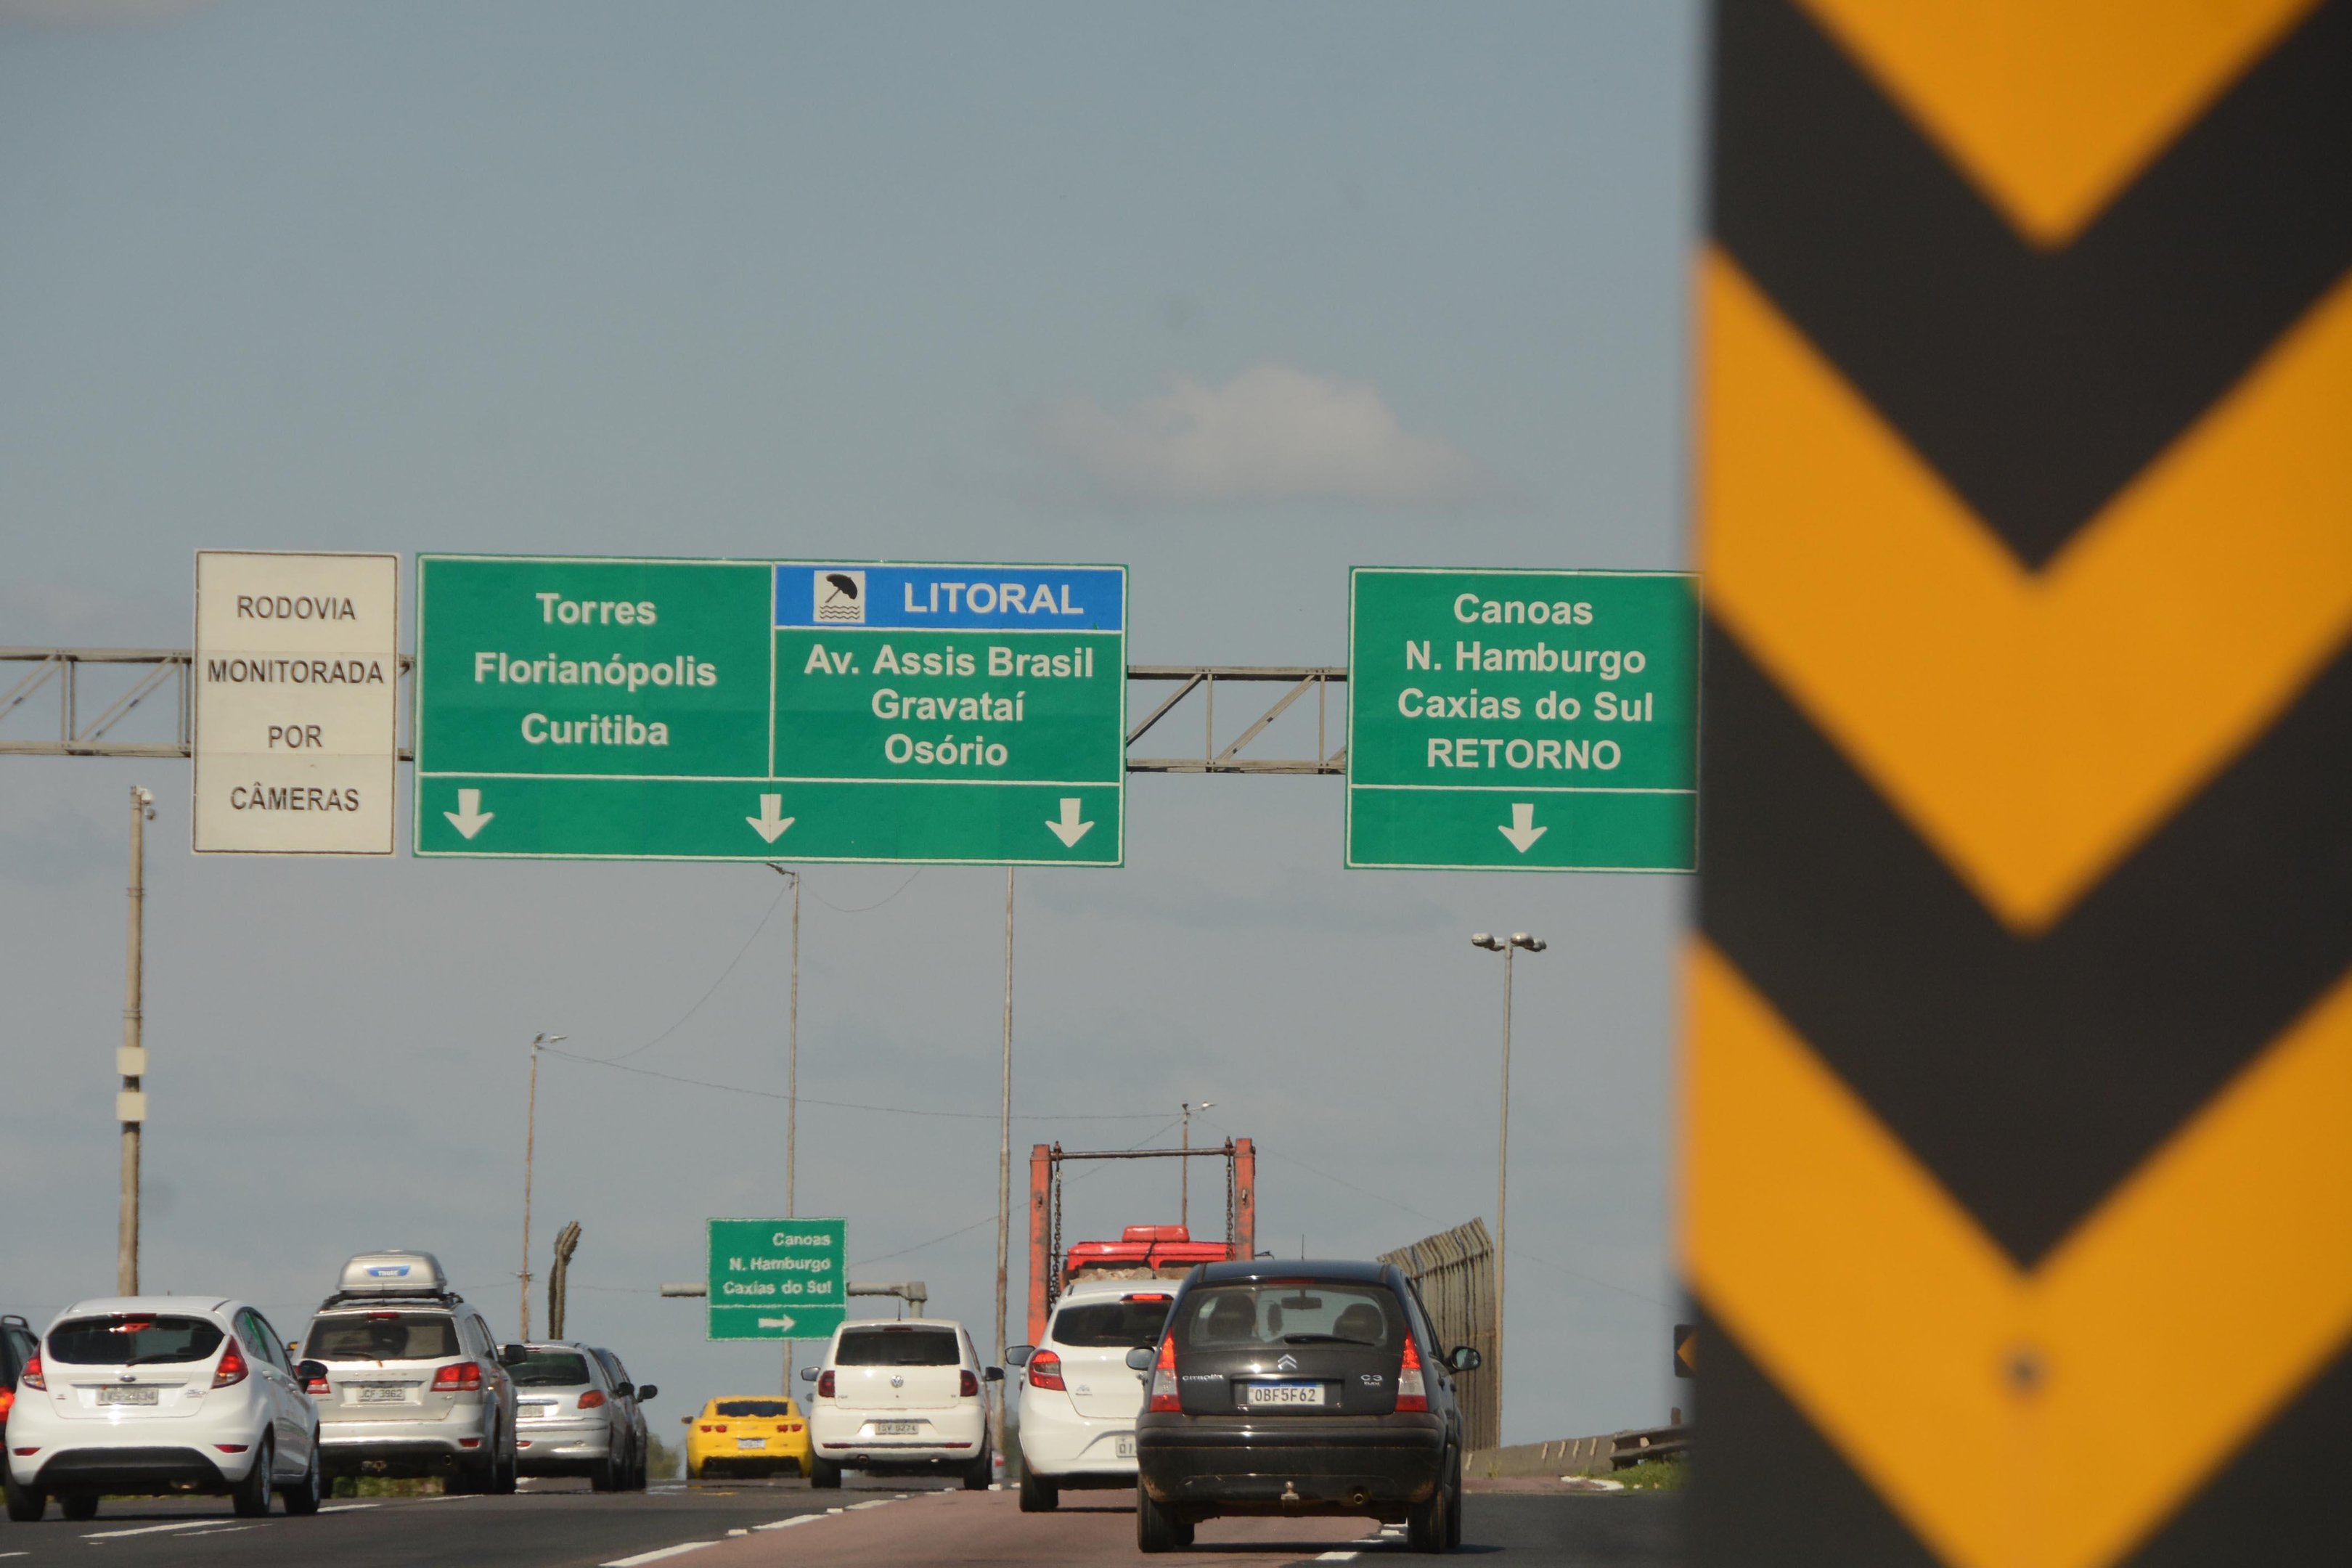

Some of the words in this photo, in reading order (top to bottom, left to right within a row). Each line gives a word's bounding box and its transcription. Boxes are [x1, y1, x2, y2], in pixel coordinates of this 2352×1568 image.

[238, 596, 355, 620] RODOVIA
[536, 593, 656, 624] Torres
[905, 583, 1084, 614] LITORAL
[1454, 593, 1593, 625] Canoas
[208, 660, 383, 683] MONITORADA
[475, 653, 716, 691] Florianópolis
[804, 644, 859, 674] Av.
[873, 645, 976, 676] Assis
[989, 647, 1093, 677] Brasil
[1407, 640, 1441, 670] N.
[1456, 641, 1646, 680] Hamburgo
[872, 689, 1025, 721] Gravataí
[1398, 688, 1521, 719] Caxias
[1535, 691, 1580, 720] do
[1594, 692, 1652, 722] Sul
[269, 725, 322, 748] POR
[522, 713, 668, 746] Curitiba
[885, 734, 1008, 766] Osório
[1428, 738, 1621, 769] RETORNO
[231, 782, 359, 811] CÂMERAS
[772, 1233, 832, 1246] Canoas
[730, 1257, 746, 1270] N.
[751, 1257, 831, 1273] Hamburgo
[723, 1281, 775, 1294] Caxias
[781, 1280, 803, 1294] do
[807, 1281, 832, 1294] Sul
[1254, 1388, 1315, 1402] OBF5F62
